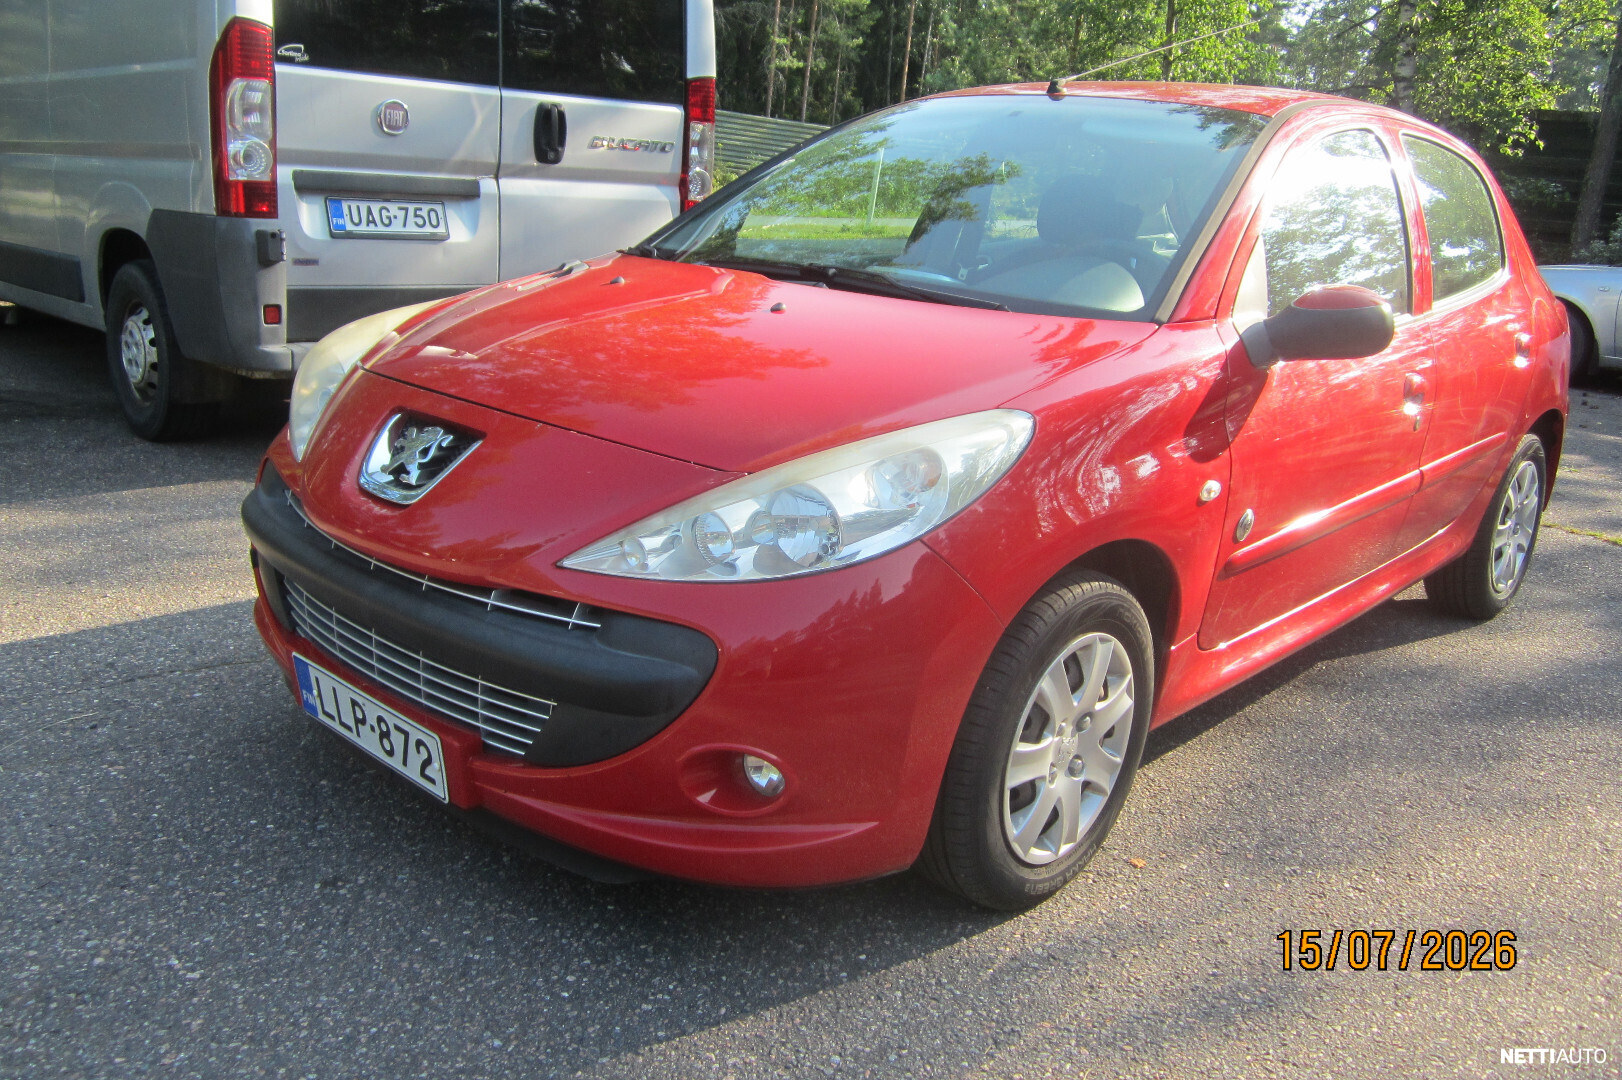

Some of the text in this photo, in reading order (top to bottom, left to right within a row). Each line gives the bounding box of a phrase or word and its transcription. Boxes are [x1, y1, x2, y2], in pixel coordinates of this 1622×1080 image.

[386, 109, 404, 126] FIAT
[333, 217, 345, 225] FIN
[347, 204, 440, 228] UAG-750
[303, 690, 317, 707] FIN
[315, 676, 437, 786] LLP-872
